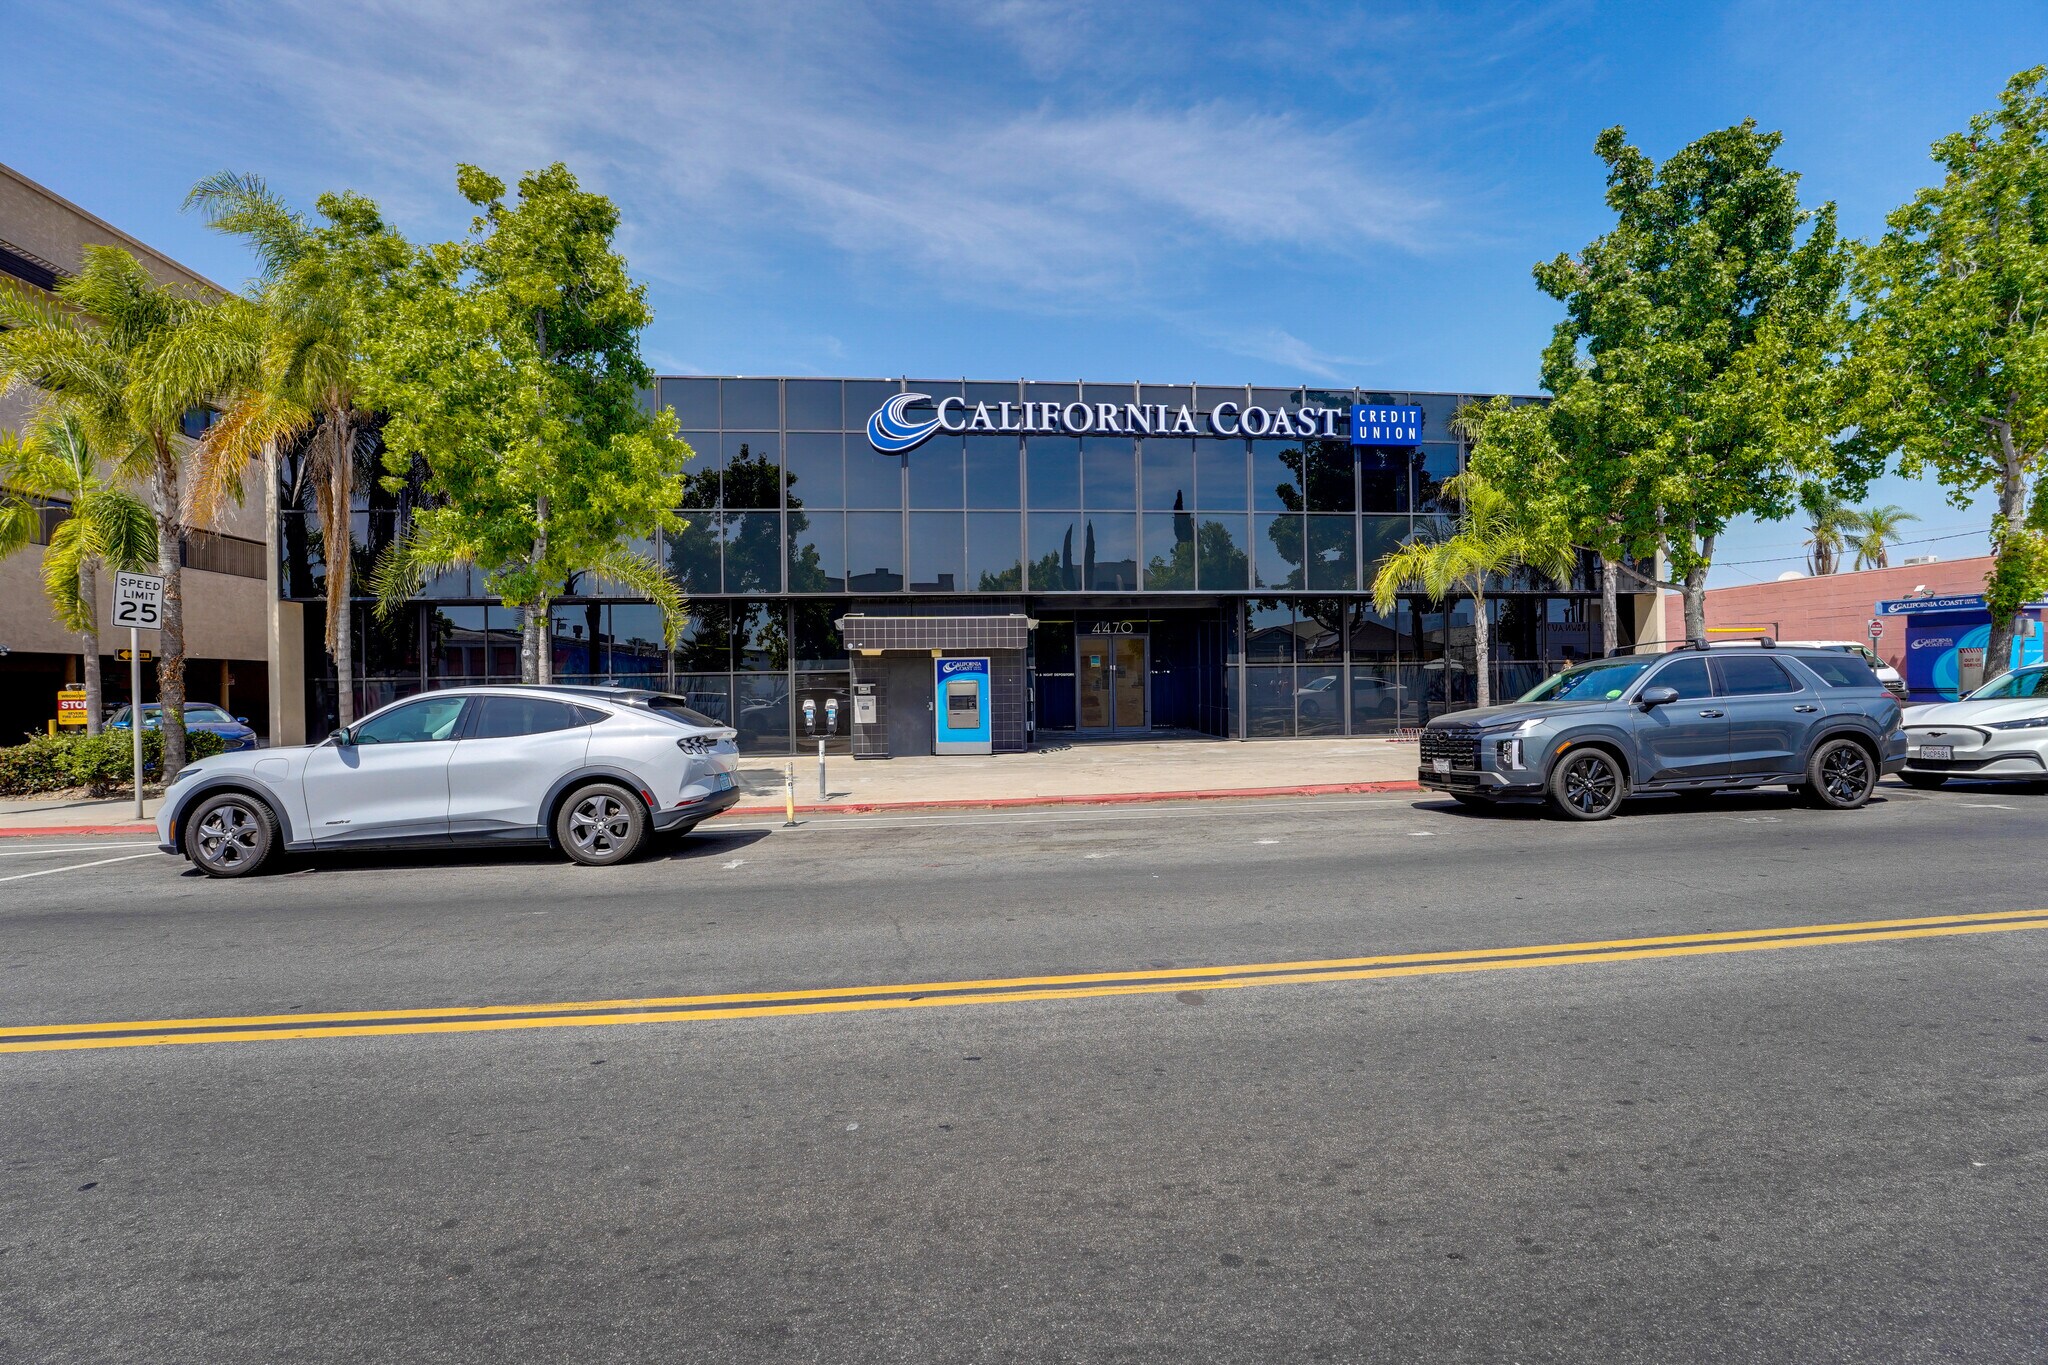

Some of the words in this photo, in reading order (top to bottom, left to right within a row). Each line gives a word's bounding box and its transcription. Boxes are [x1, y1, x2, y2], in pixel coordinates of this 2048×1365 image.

[937, 396, 1199, 434] CALIFORNIA
[1212, 401, 1342, 436] COAST
[1359, 409, 1417, 424] CREDIT
[1359, 426, 1416, 440] UNION
[120, 577, 161, 591] SPEED
[123, 589, 156, 601] LIMIT
[1897, 601, 1938, 610] CALIFORNIA
[1938, 599, 1964, 607] COAST
[119, 601, 157, 623] 25
[1092, 621, 1133, 634] 4470
